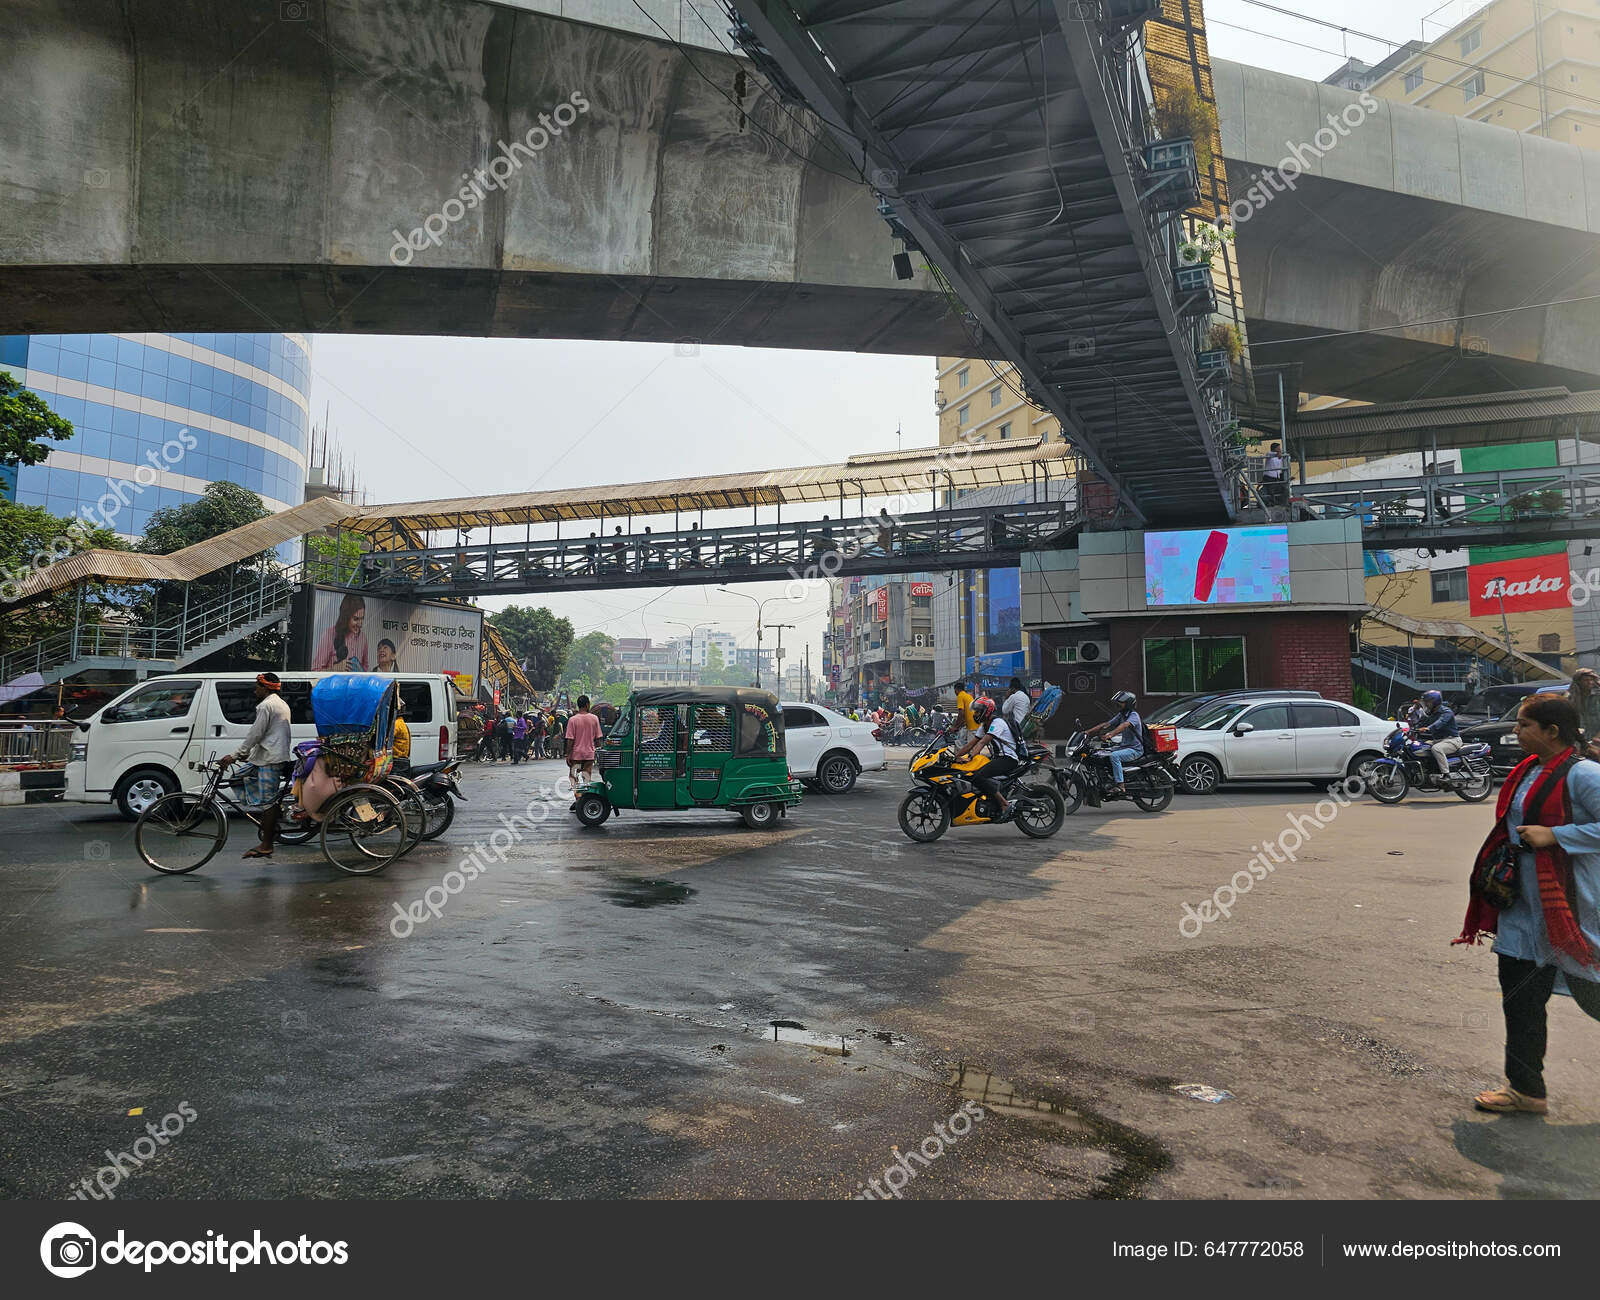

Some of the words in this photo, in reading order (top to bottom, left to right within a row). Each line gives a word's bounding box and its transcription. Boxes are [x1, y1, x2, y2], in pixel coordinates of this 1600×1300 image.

[1481, 575, 1564, 599] Bata
[402, 623, 409, 631] ও
[458, 625, 475, 639] ঠিক
